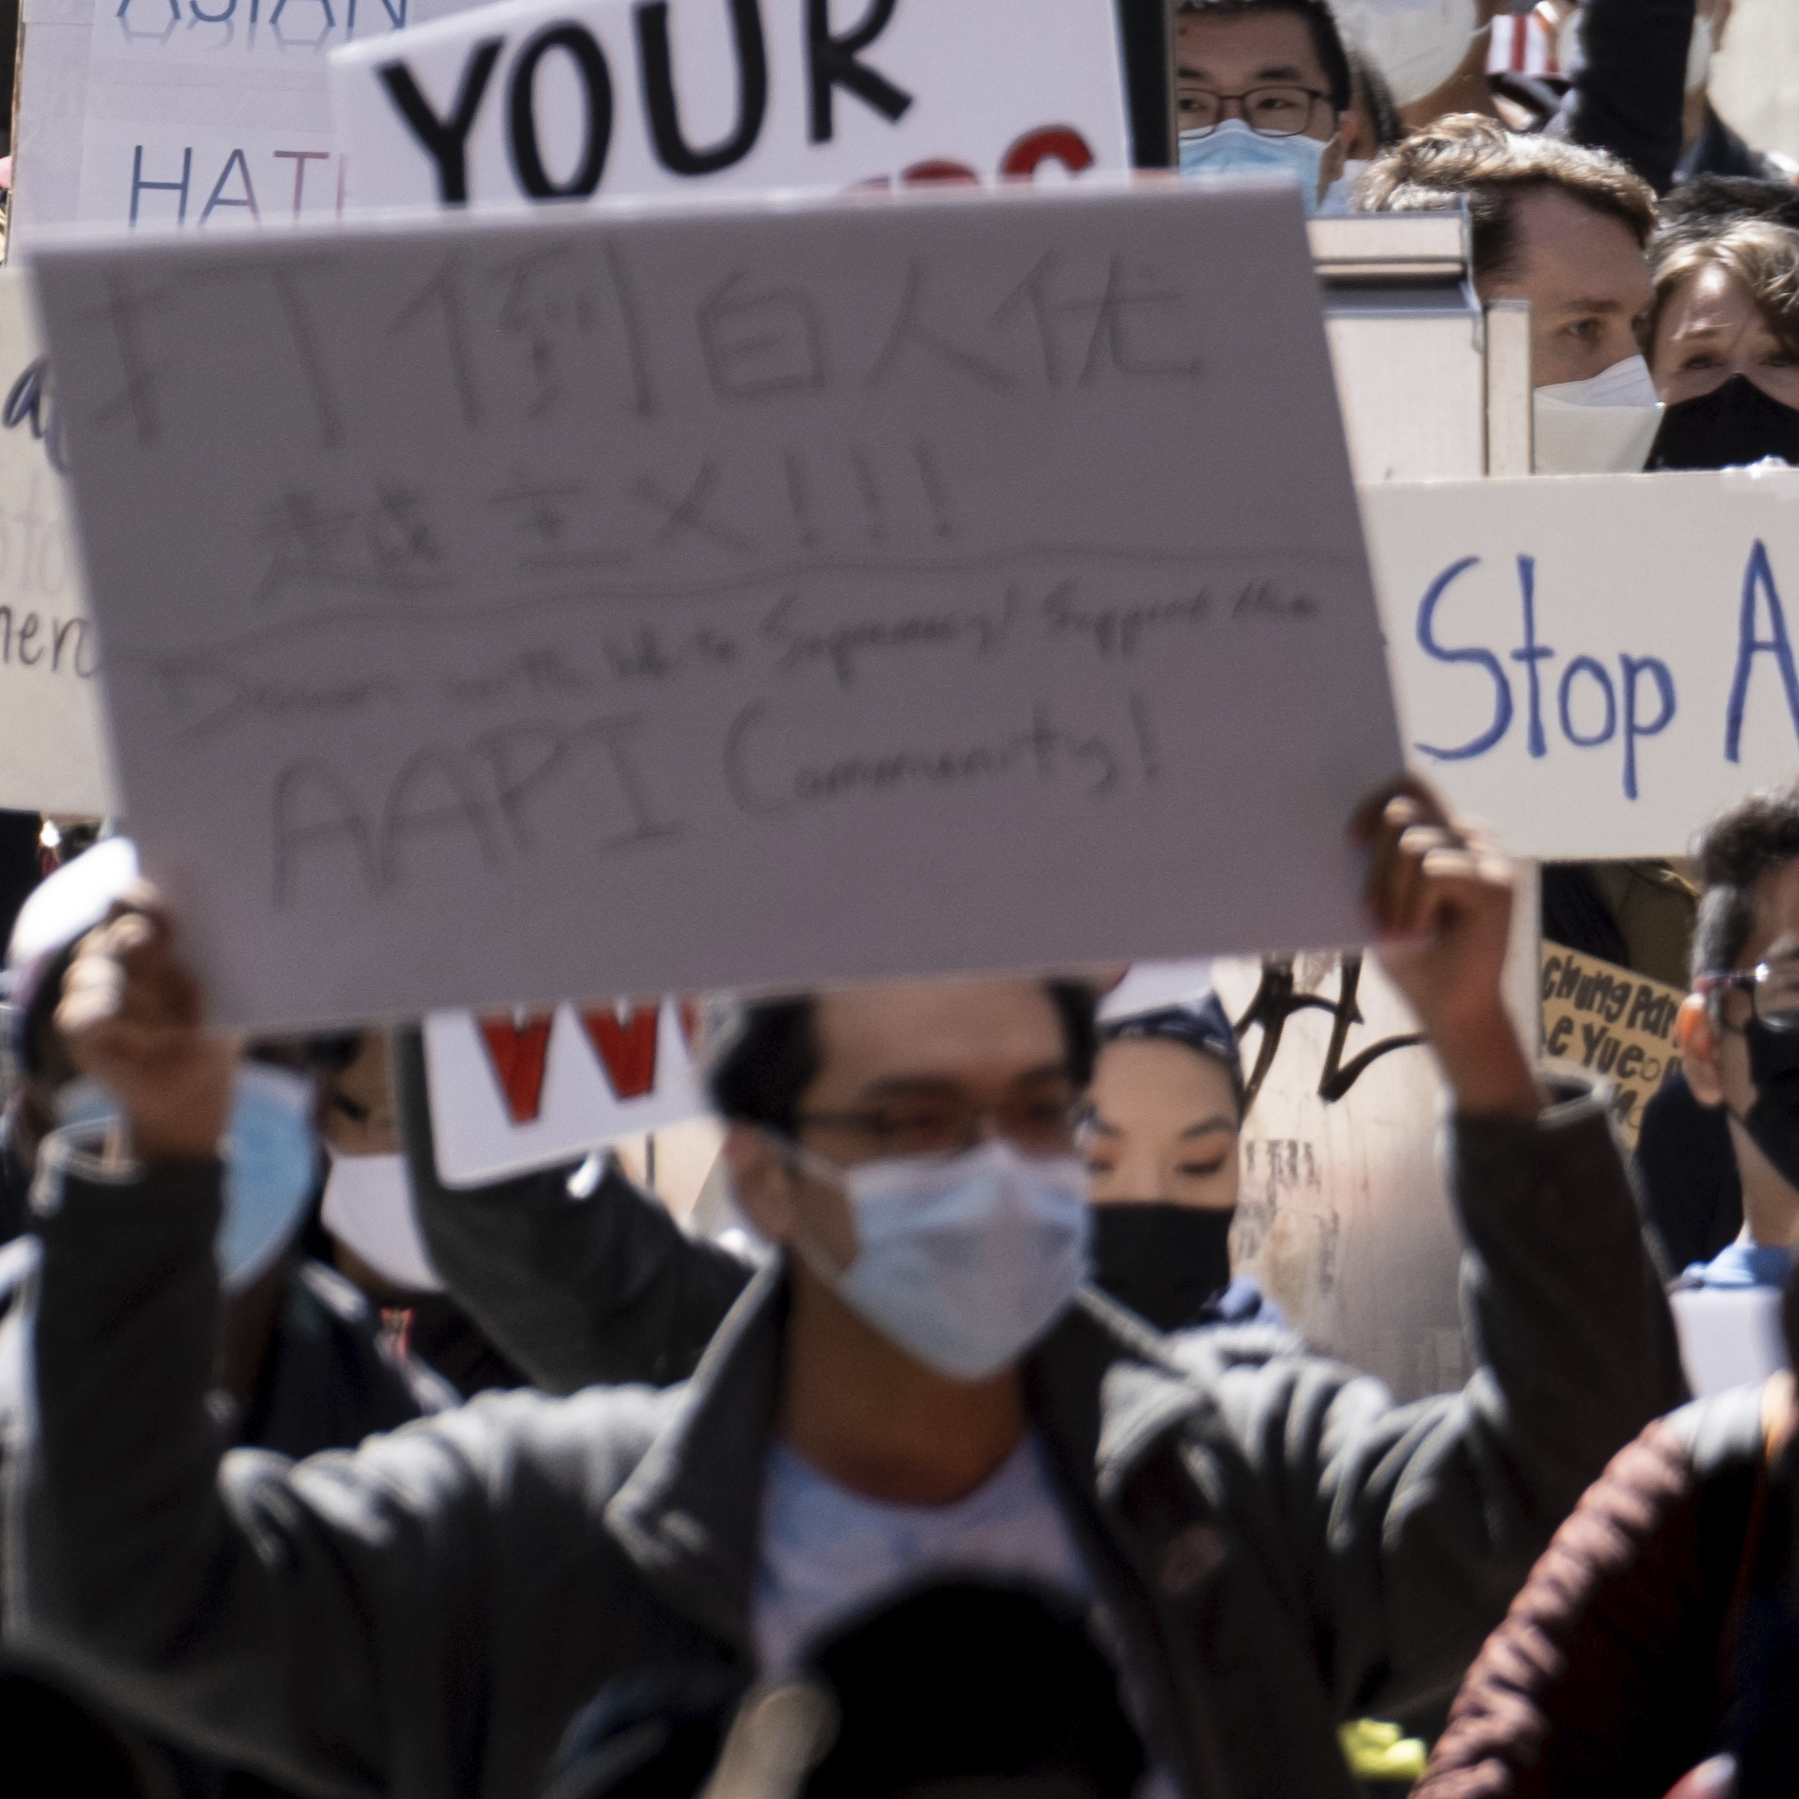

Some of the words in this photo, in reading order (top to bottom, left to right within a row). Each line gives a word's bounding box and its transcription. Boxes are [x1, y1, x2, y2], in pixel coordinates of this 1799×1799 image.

[129, 144, 348, 230] HAT
[1413, 553, 1678, 801] Stop
[269, 711, 688, 911] AAPI
